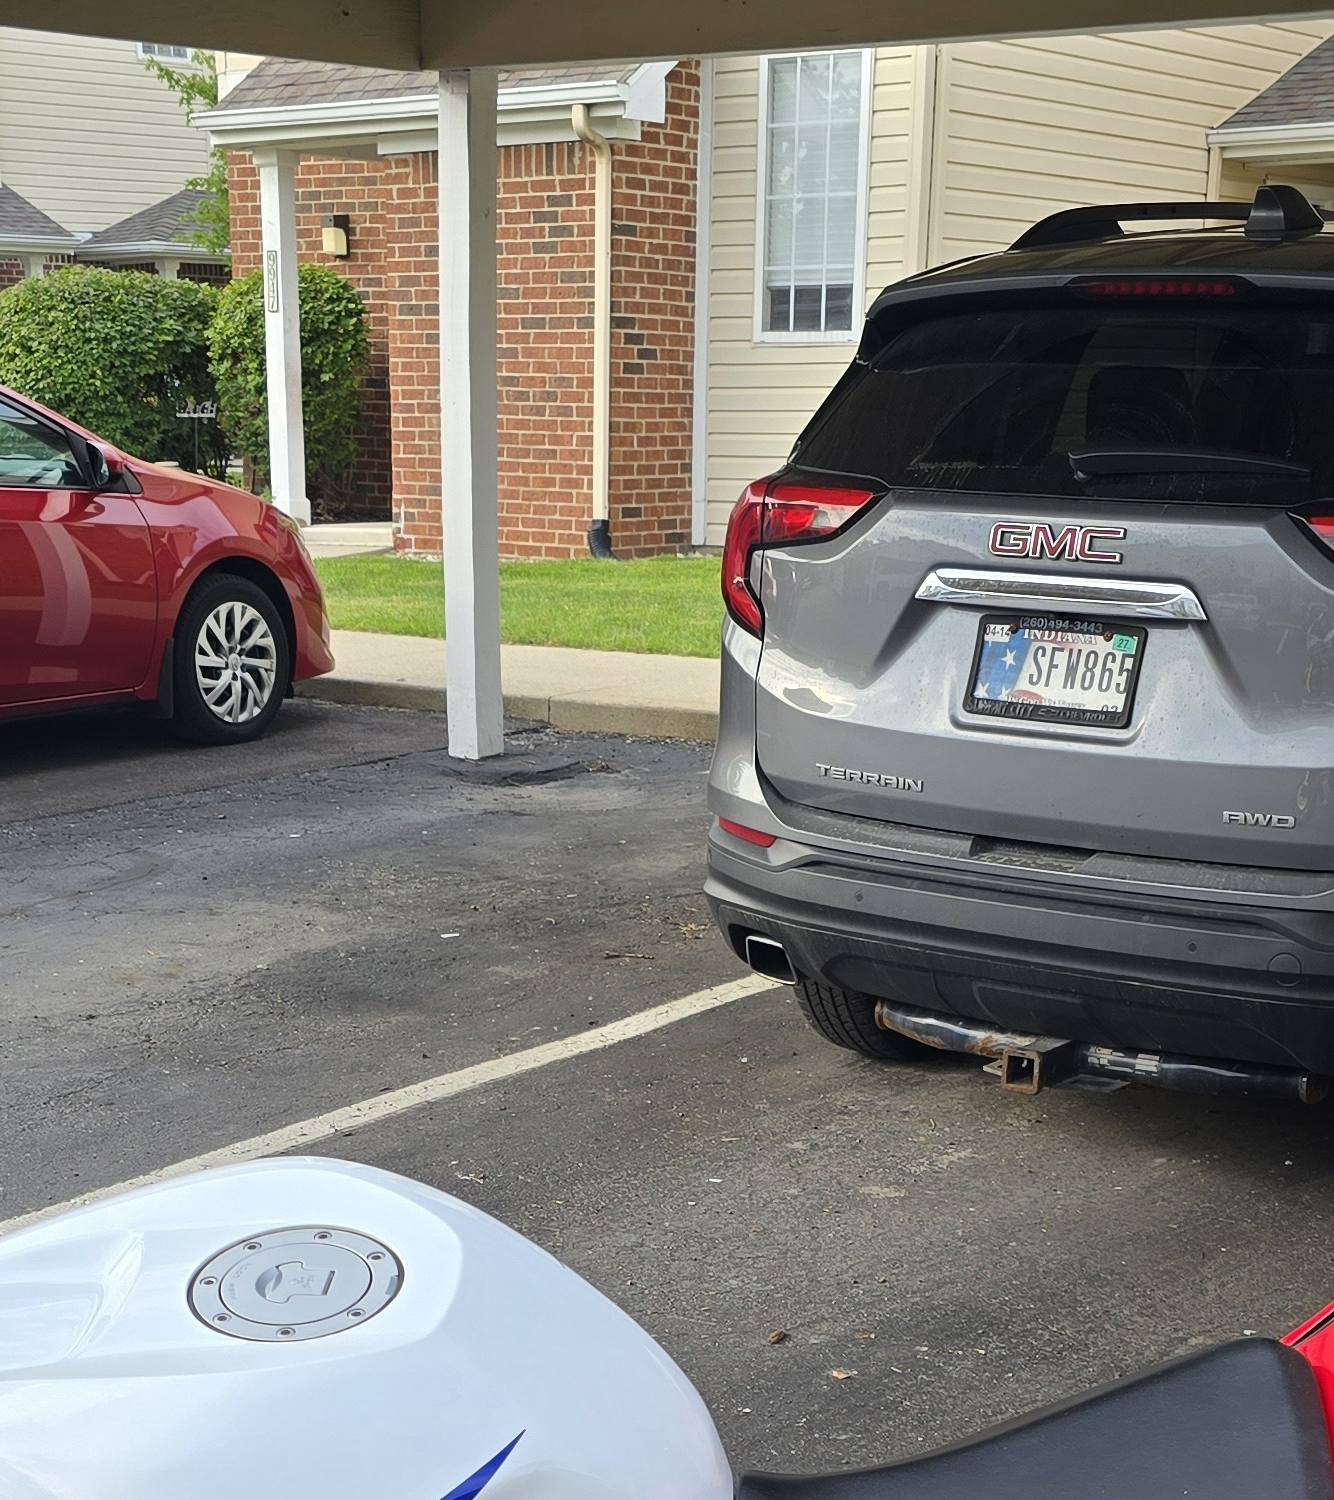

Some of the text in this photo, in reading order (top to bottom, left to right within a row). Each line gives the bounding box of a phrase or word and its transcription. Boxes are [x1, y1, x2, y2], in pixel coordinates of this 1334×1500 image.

[989, 522, 1125, 563] GMC
[1019, 616, 1104, 634] (260)494-3443
[1022, 628, 1098, 646] INDIANA
[1117, 638, 1129, 649] 27
[1028, 645, 1133, 695] SFW865
[815, 763, 923, 792] TERRAIN
[1222, 811, 1295, 828] AWD
